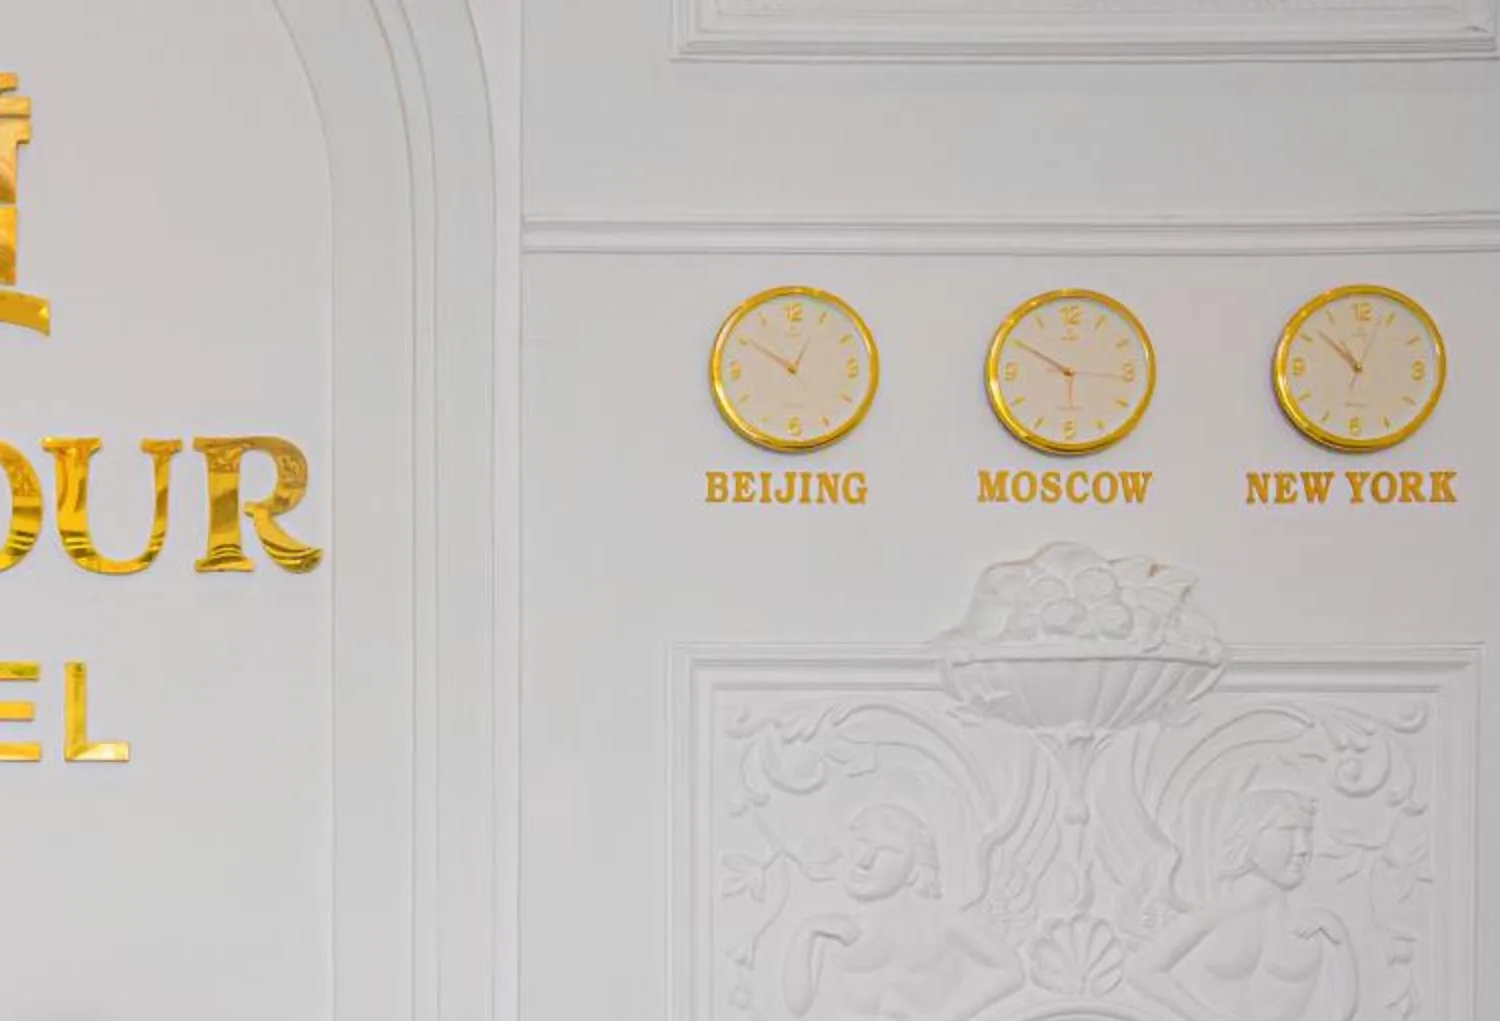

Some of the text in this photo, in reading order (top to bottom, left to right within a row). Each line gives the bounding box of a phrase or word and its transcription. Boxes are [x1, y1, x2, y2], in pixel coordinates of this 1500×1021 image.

[705, 471, 869, 505] BEIJING
[978, 470, 1154, 505] MOSCOW
[1246, 470, 1457, 505] NEW YORK
